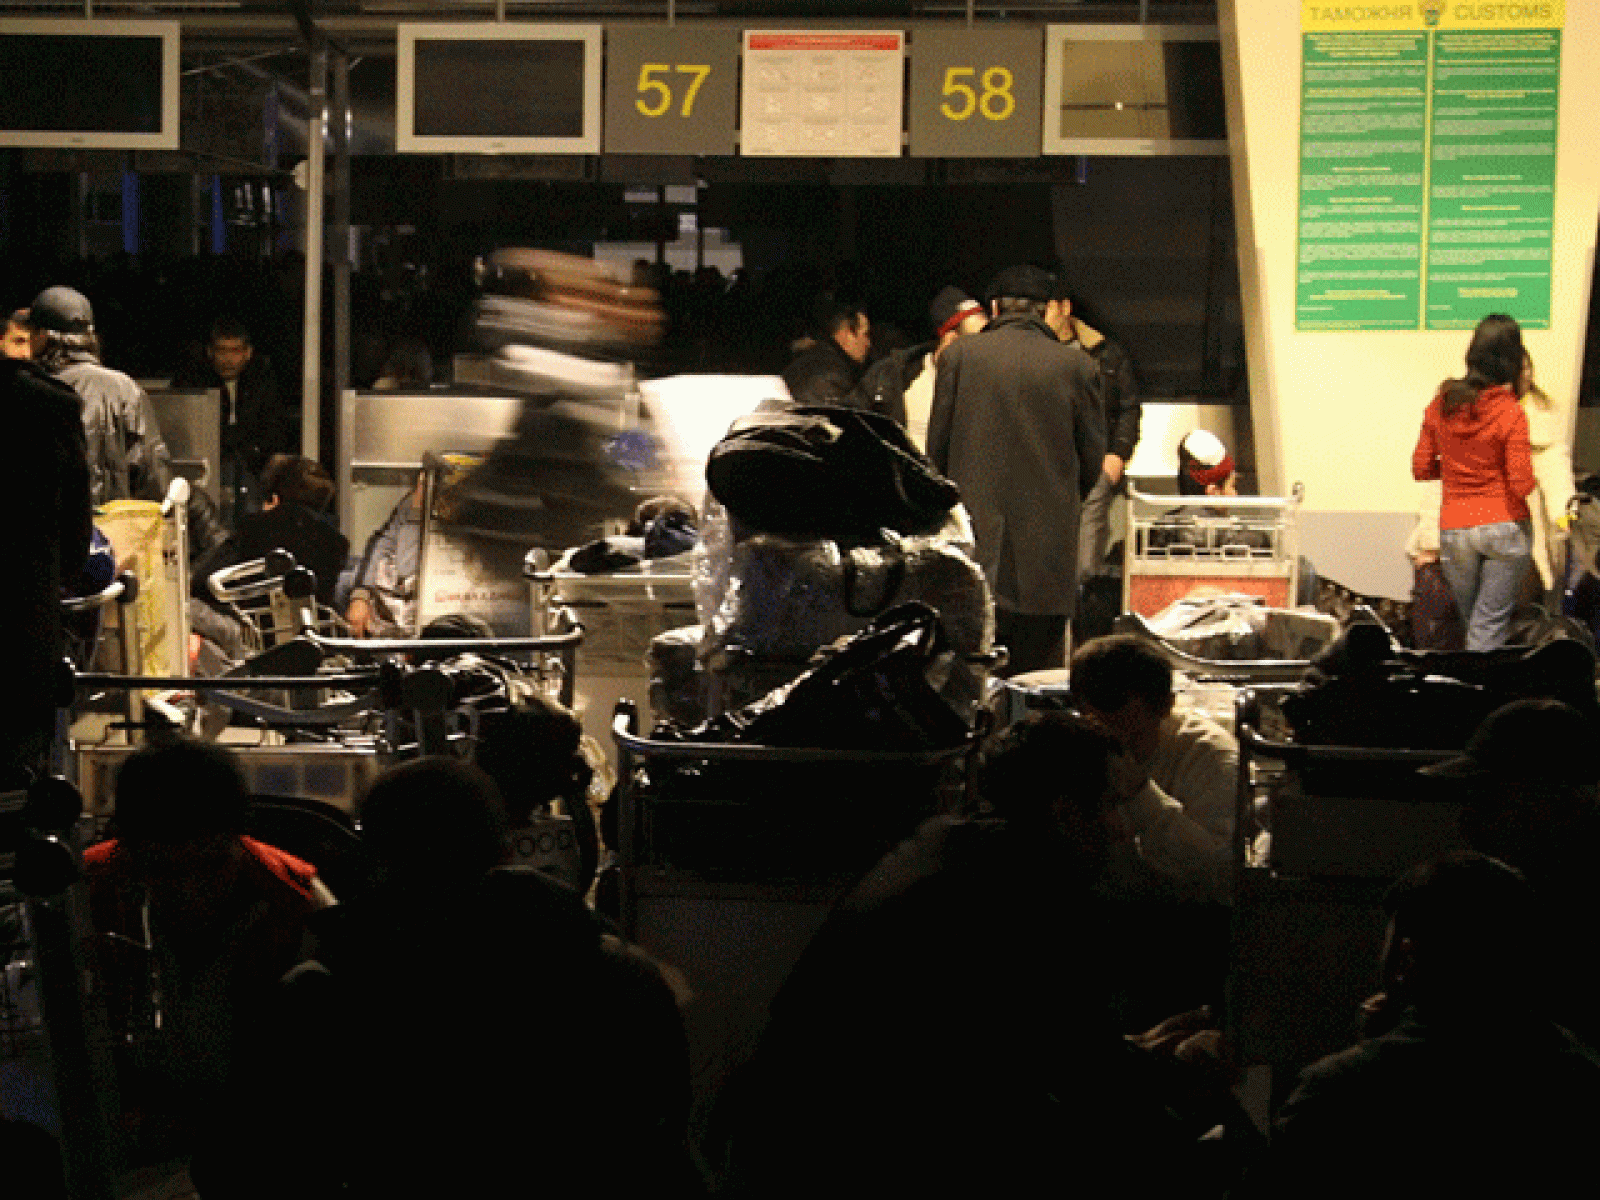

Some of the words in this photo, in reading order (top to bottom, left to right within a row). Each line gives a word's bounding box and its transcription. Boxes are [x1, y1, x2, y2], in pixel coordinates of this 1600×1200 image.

[1454, 4, 1552, 21] CUSTOMS
[635, 63, 712, 117] 57
[939, 66, 1016, 121] 58
